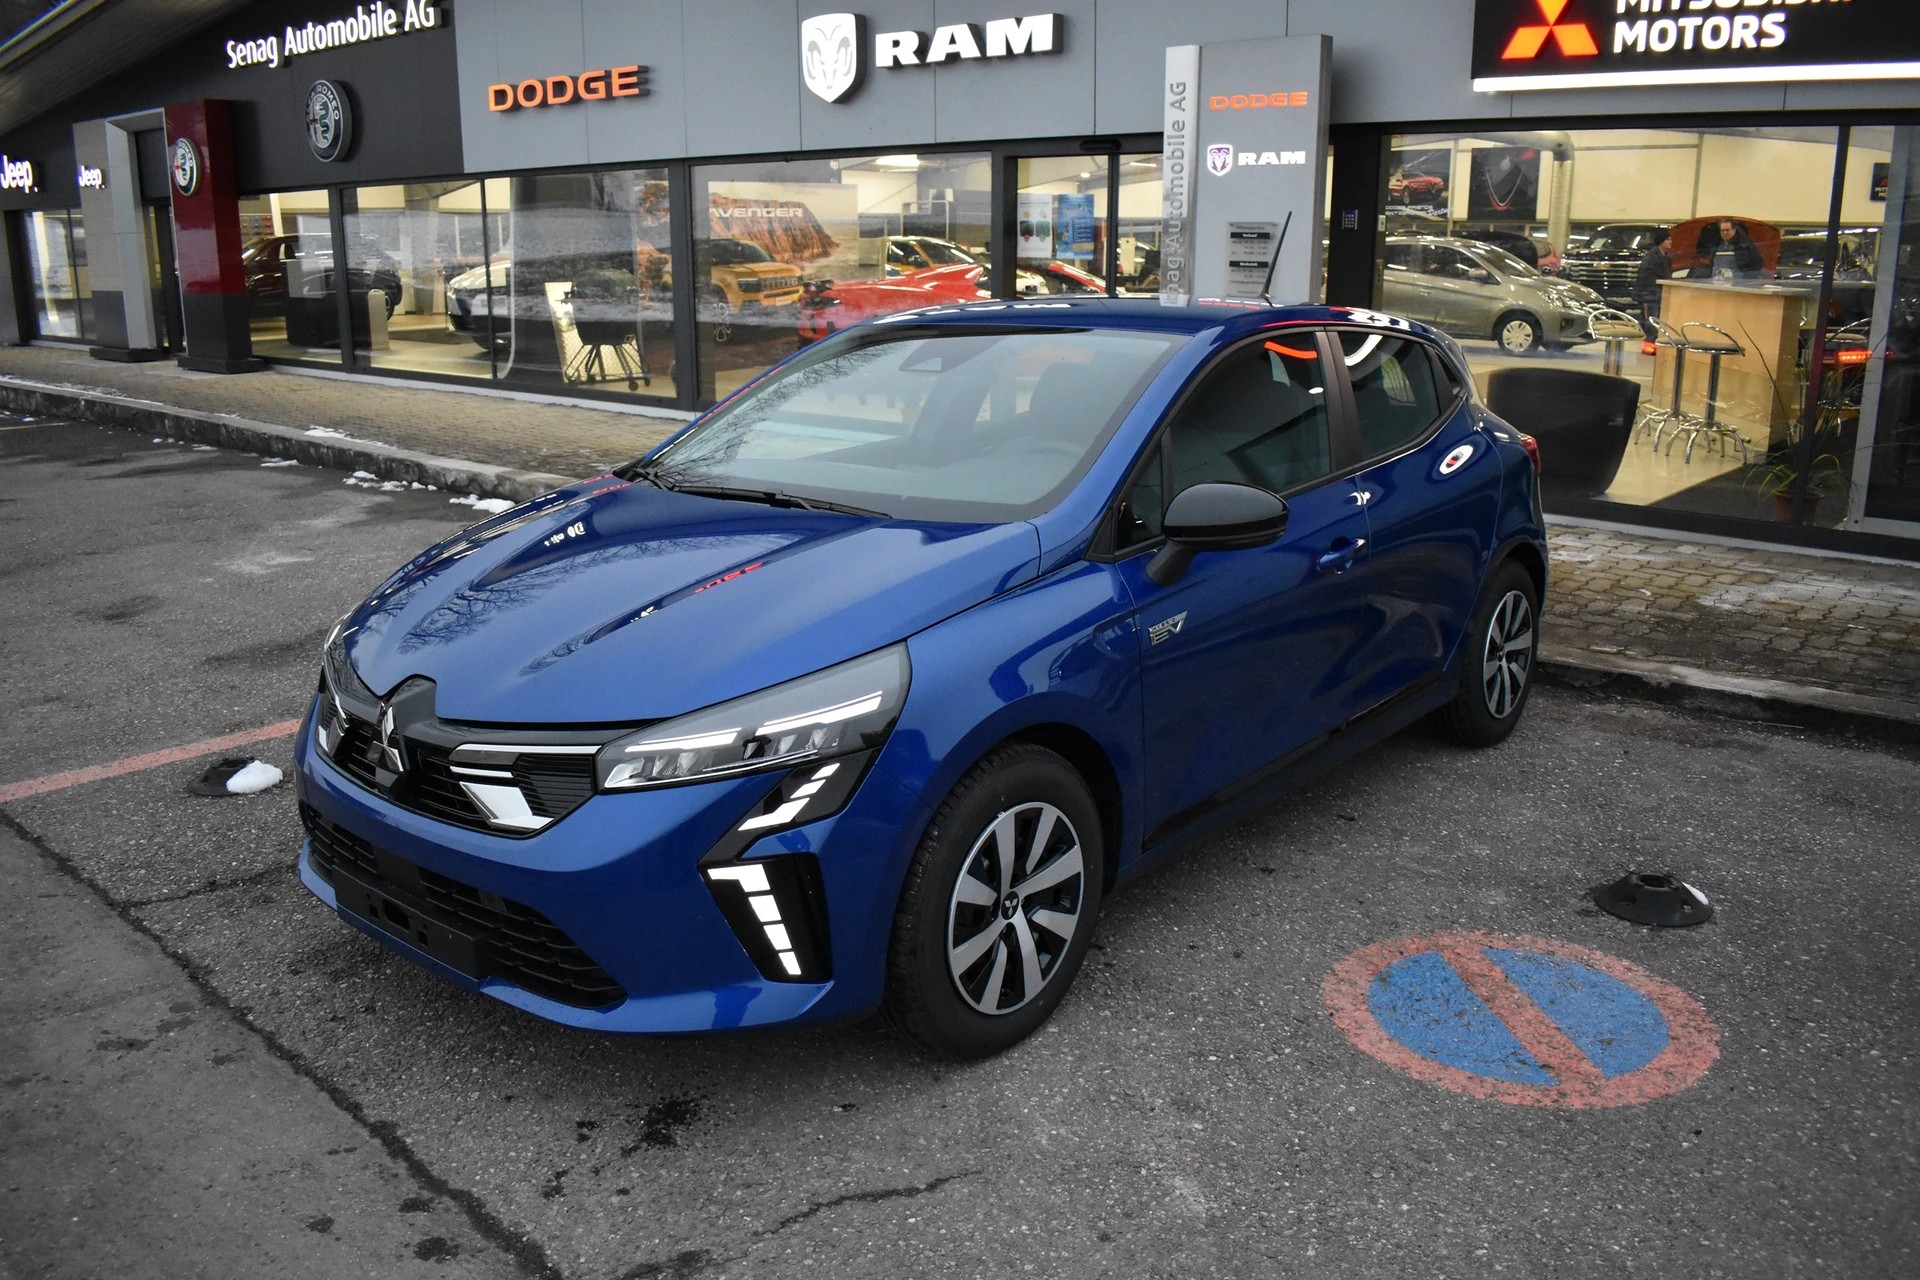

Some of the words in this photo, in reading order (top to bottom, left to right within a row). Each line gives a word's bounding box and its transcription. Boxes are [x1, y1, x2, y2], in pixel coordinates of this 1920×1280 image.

[226, 36, 277, 69] Senag
[283, 1, 397, 56] Automobile
[403, 0, 435, 32] AG
[875, 13, 1055, 69] RAM
[1613, 13, 1787, 53] MOTORS
[487, 64, 641, 112] DODGE
[1169, 81, 1187, 112] AG
[1209, 91, 1308, 111] DODGE
[1238, 151, 1306, 166] RAM
[1165, 119, 1186, 247] Automobile
